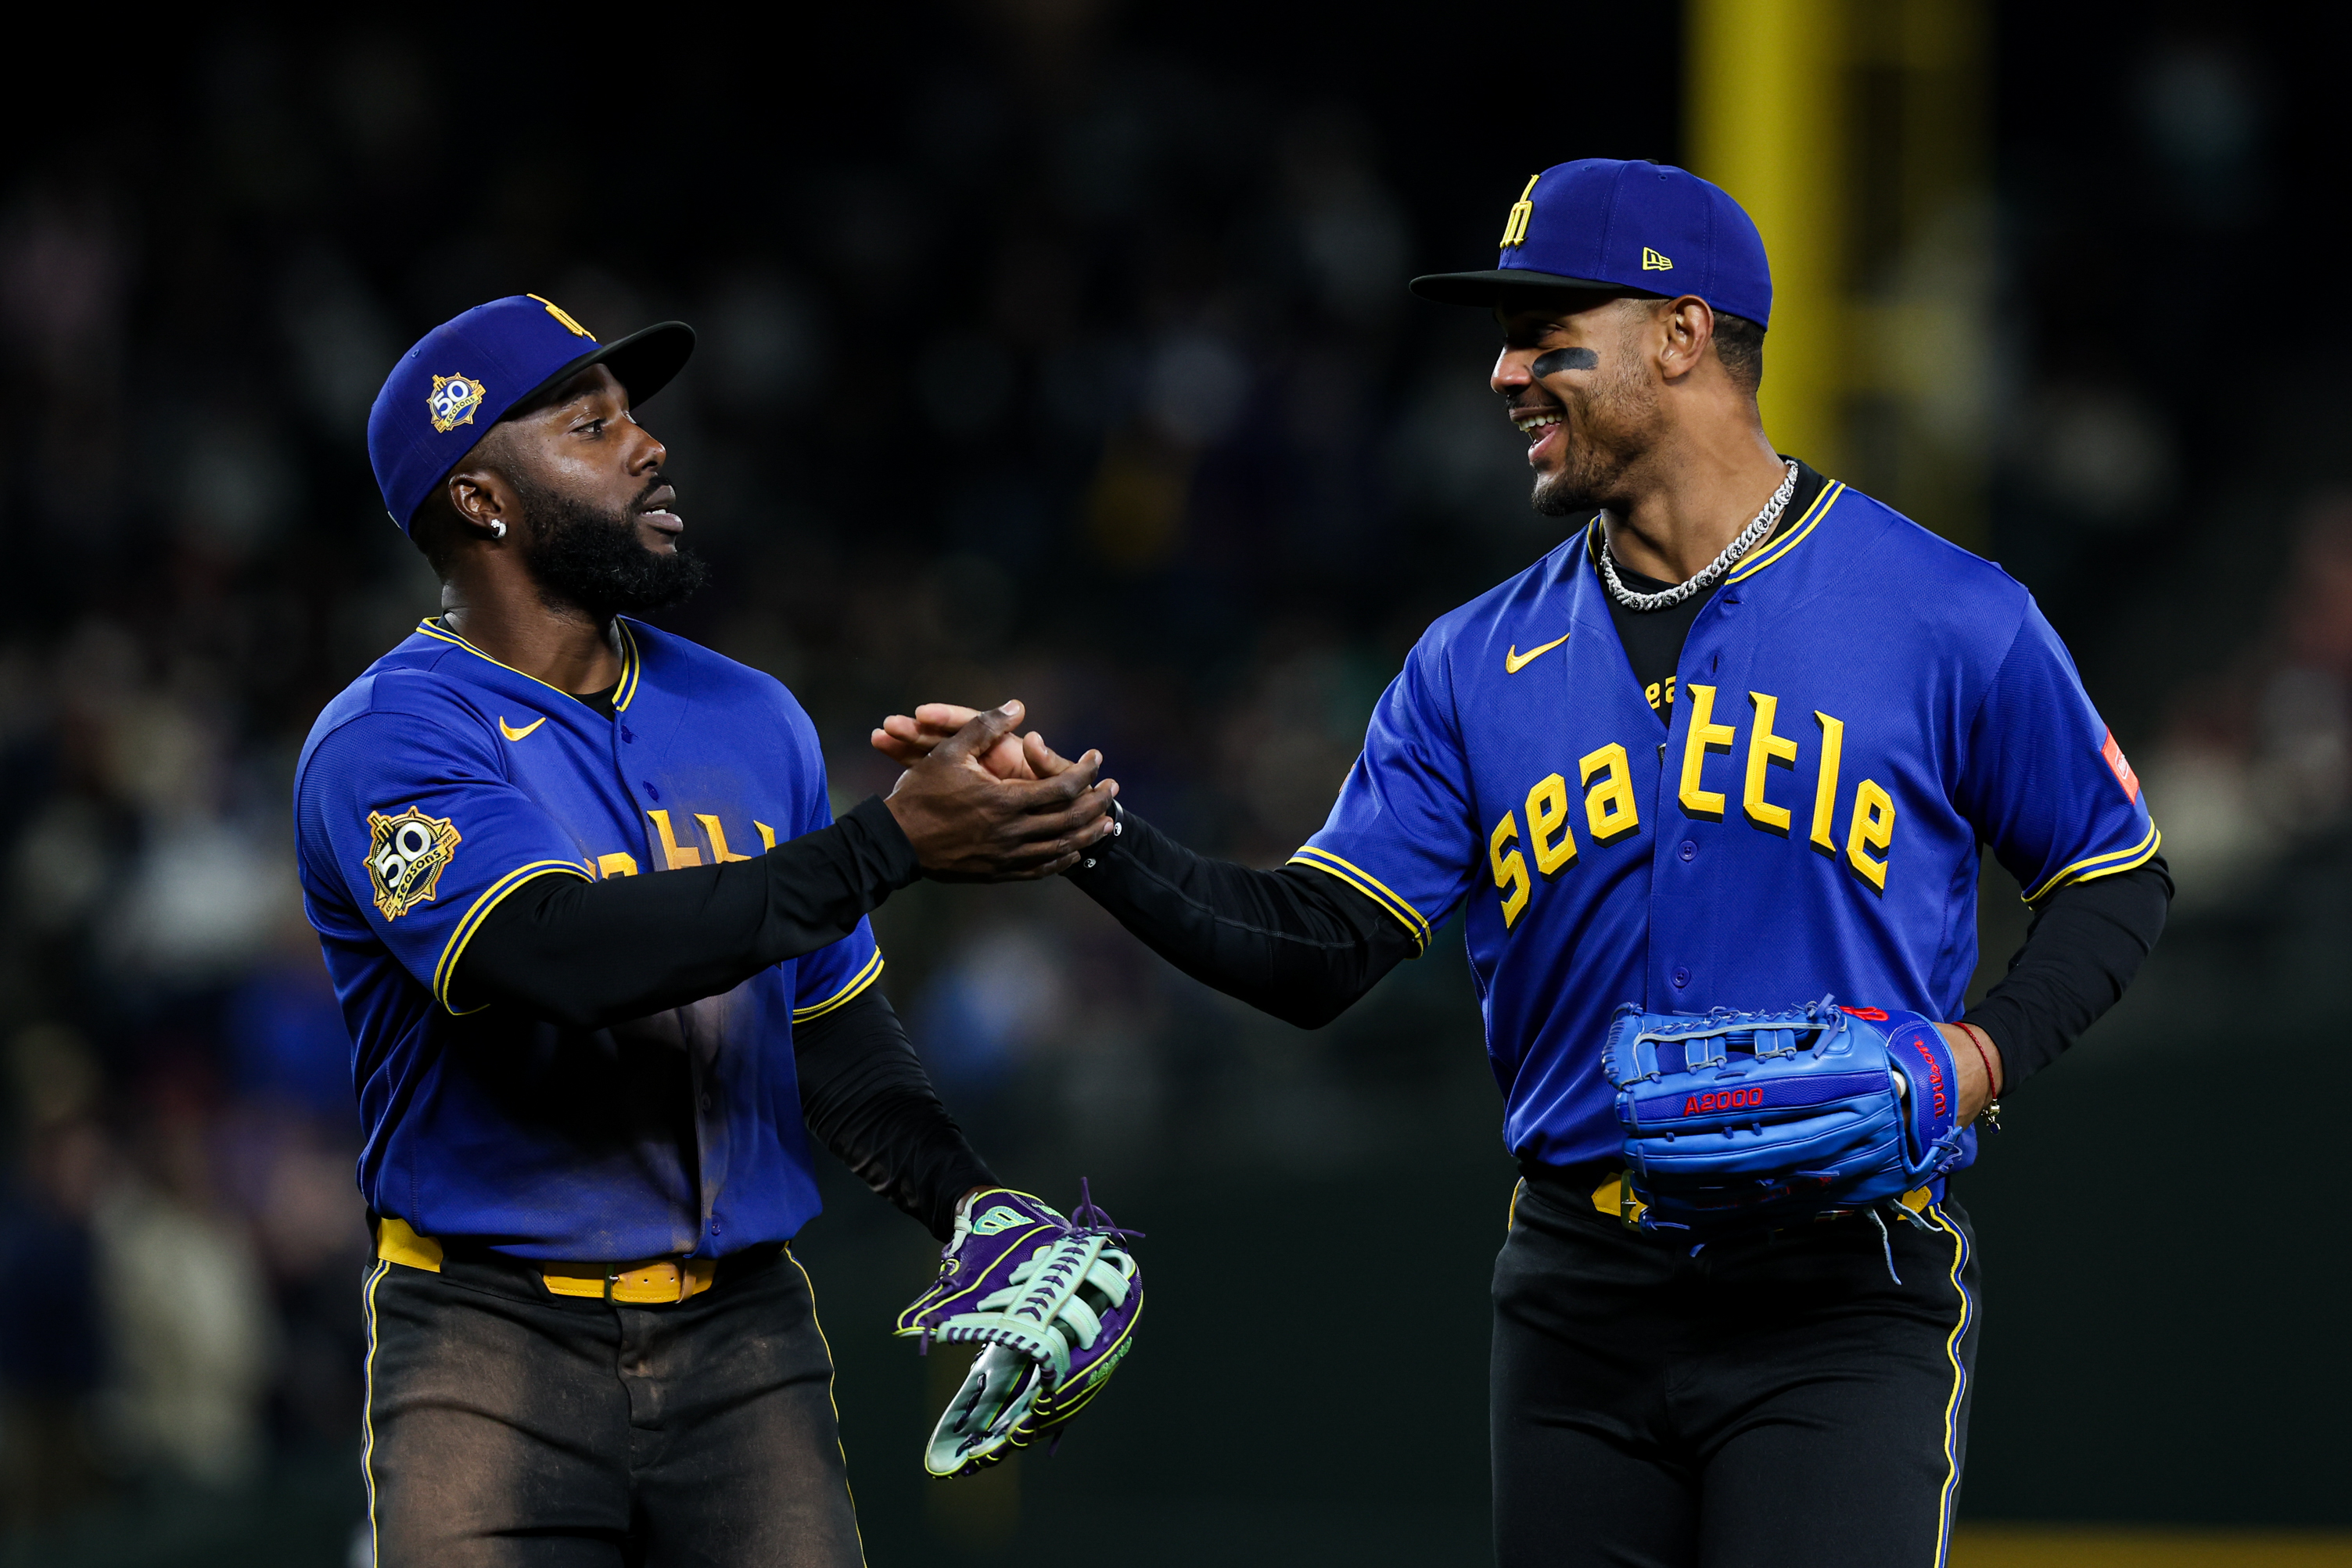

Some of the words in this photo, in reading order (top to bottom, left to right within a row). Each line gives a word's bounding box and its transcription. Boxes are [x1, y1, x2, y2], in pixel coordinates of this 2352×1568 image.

[433, 380, 469, 417] 50
[447, 397, 475, 424] seasons
[1489, 684, 1896, 937] seattle
[374, 822, 431, 888] 50
[397, 850, 441, 902] seasons
[1682, 1087, 1763, 1118] A2000
[1913, 1039, 1947, 1120] Wilson
